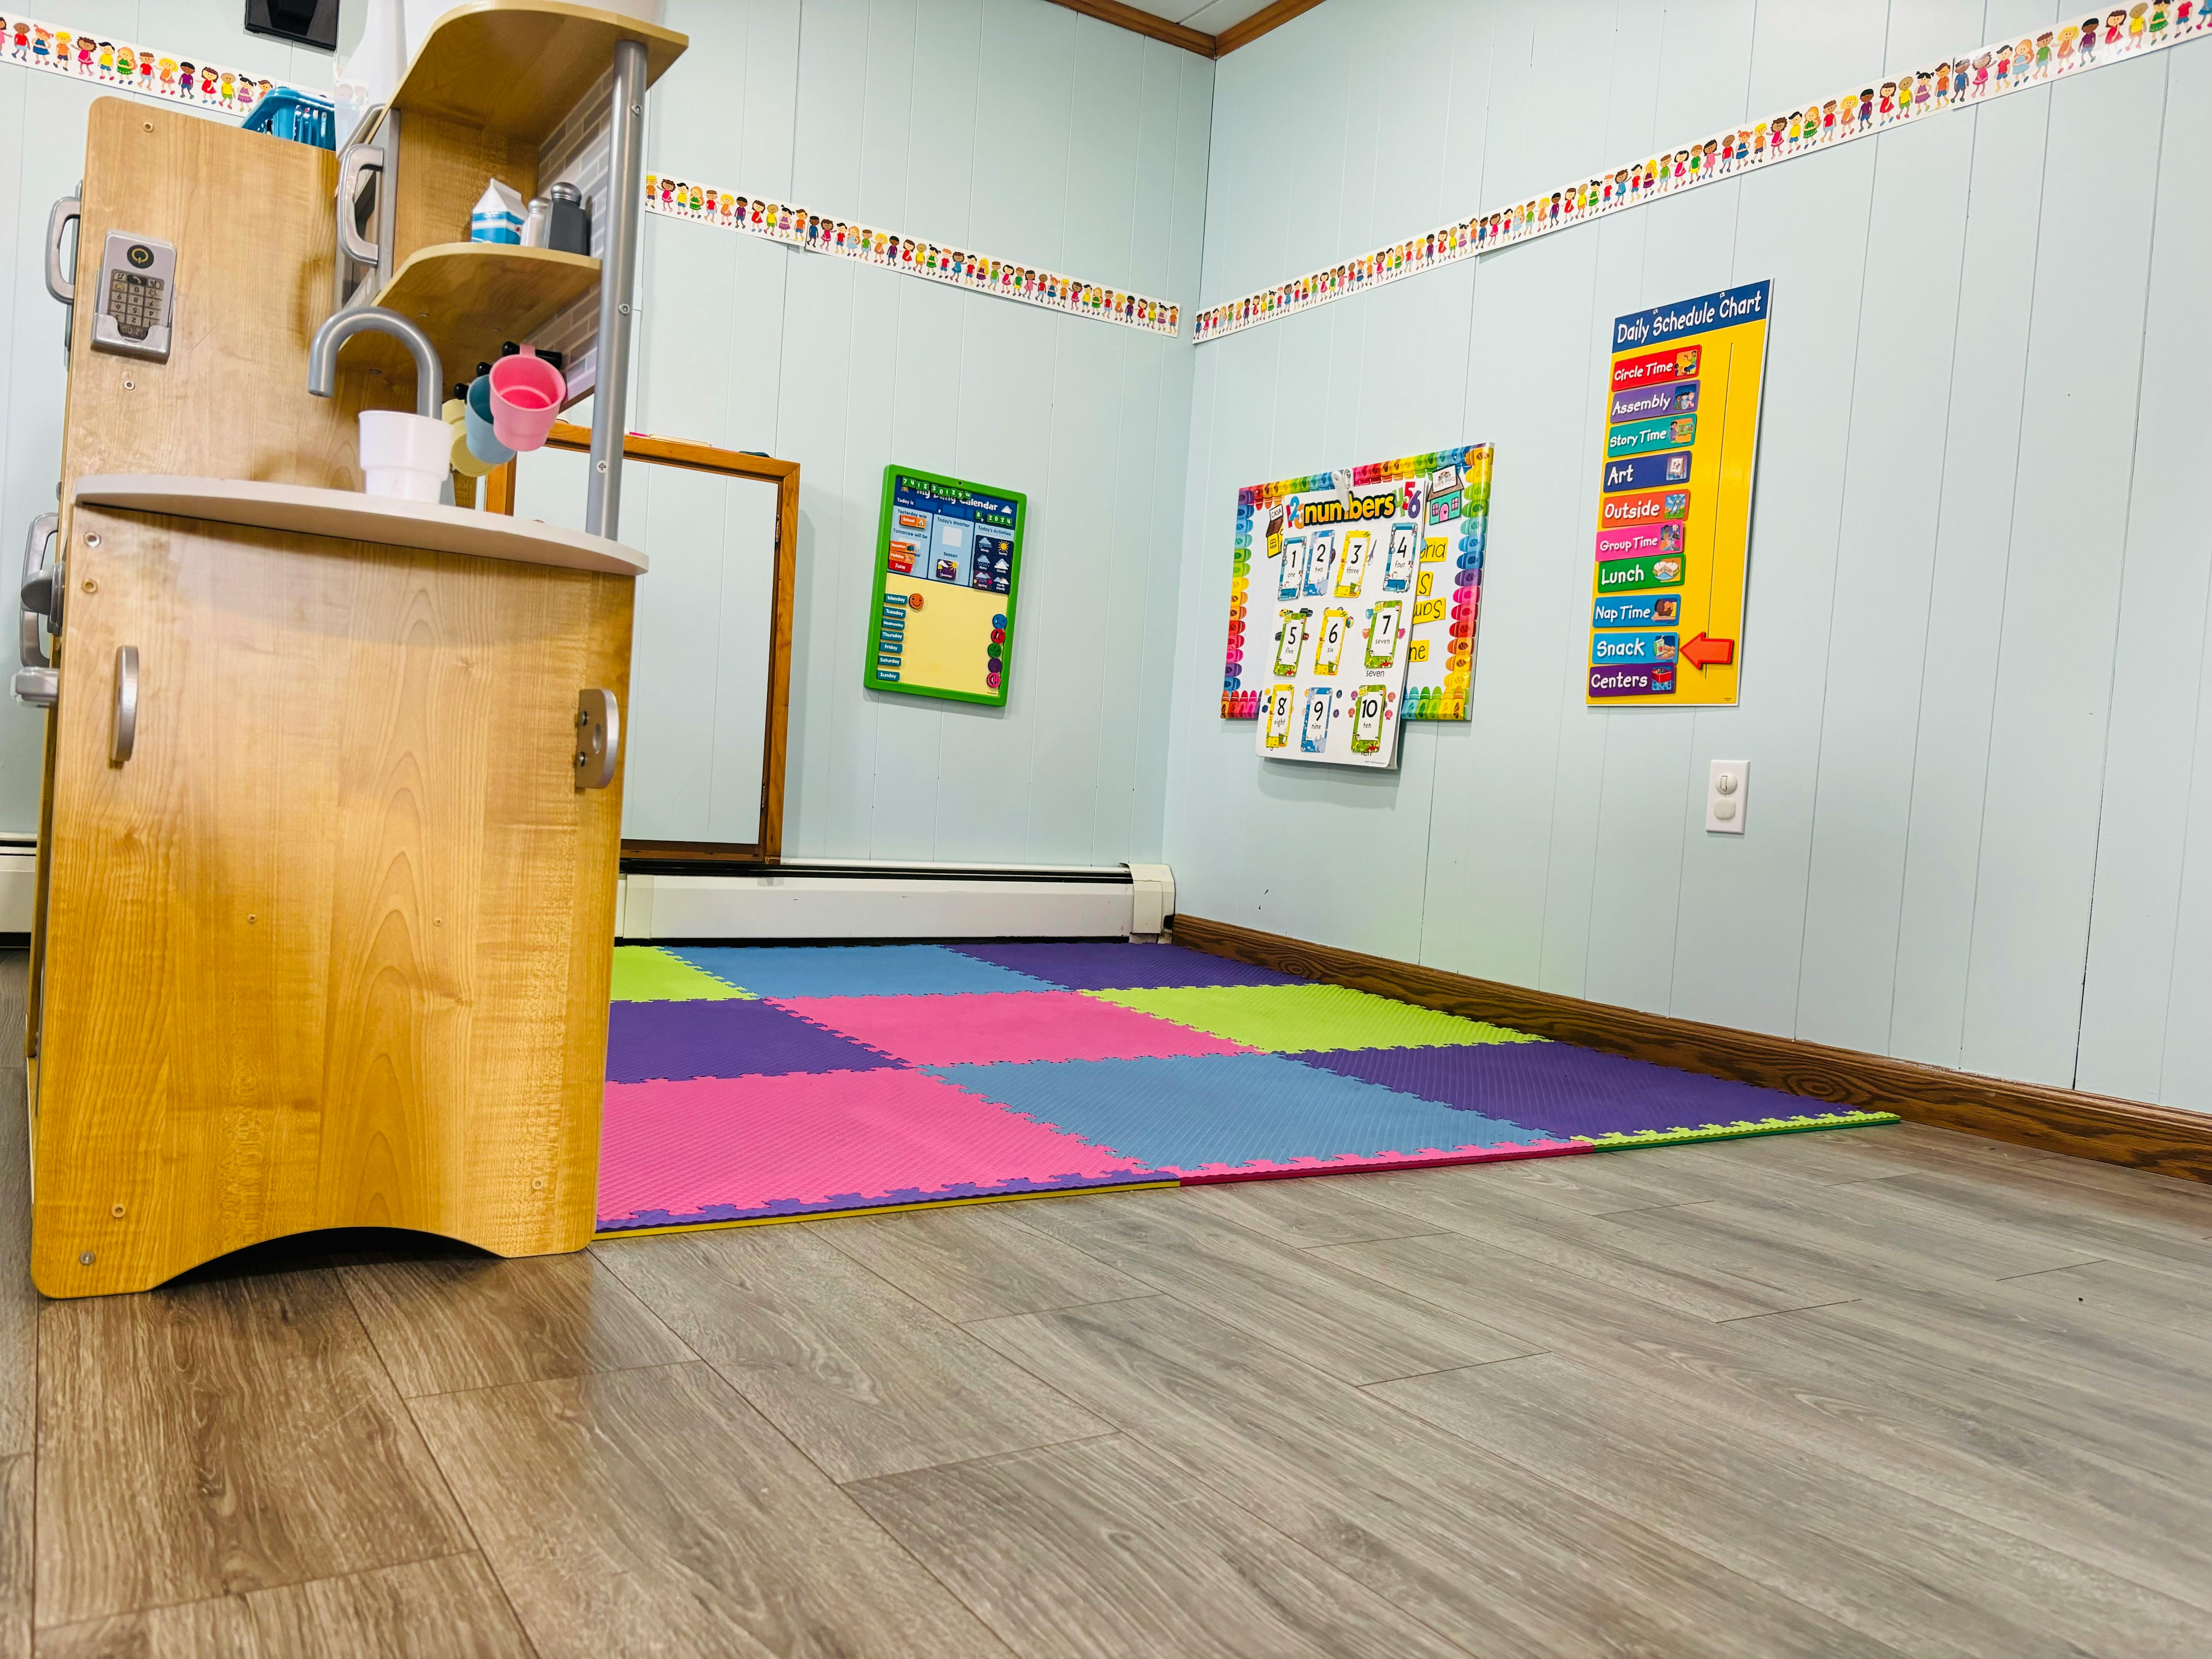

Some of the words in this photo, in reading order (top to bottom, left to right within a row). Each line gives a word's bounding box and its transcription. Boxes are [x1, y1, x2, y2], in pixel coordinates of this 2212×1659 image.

[1617, 317, 1649, 344] Daily
[1653, 302, 1714, 337] Schedule
[1720, 290, 1761, 319] Chart
[1614, 363, 1644, 381] Circle
[1645, 360, 1674, 377] Time
[1612, 393, 1671, 416] Assembly
[1610, 433, 1638, 448] Story
[1639, 429, 1667, 444] Time
[1607, 464, 1633, 486] Art
[898, 509, 918, 518] Yesterday
[959, 498, 998, 510] Calendar
[1271, 509, 1281, 518] CASA
[1305, 490, 1394, 525] numbers
[1604, 500, 1660, 519] Outside
[937, 517, 952, 526] Today's
[893, 528, 914, 536] Tomorrow
[1396, 536, 1407, 558] 4
[1600, 539, 1631, 551] Group
[1633, 536, 1658, 549] Time
[1292, 550, 1296, 568] 1
[1317, 544, 1326, 563] 2
[1351, 545, 1362, 564] 3
[1346, 566, 1359, 574] three
[1601, 564, 1644, 585] Lunch
[886, 608, 903, 617] Tuesday
[1595, 606, 1618, 622] Nap
[1620, 605, 1651, 620] Time
[1329, 623, 1338, 644] 6
[1383, 615, 1391, 634] 7
[1288, 627, 1297, 644] 5
[1597, 638, 1645, 657] Snack
[1591, 674, 1648, 689] Centers
[1277, 697, 1287, 716] 8
[1314, 701, 1323, 721] 9
[1362, 699, 1377, 718] 10
[1274, 718, 1285, 727] eight
